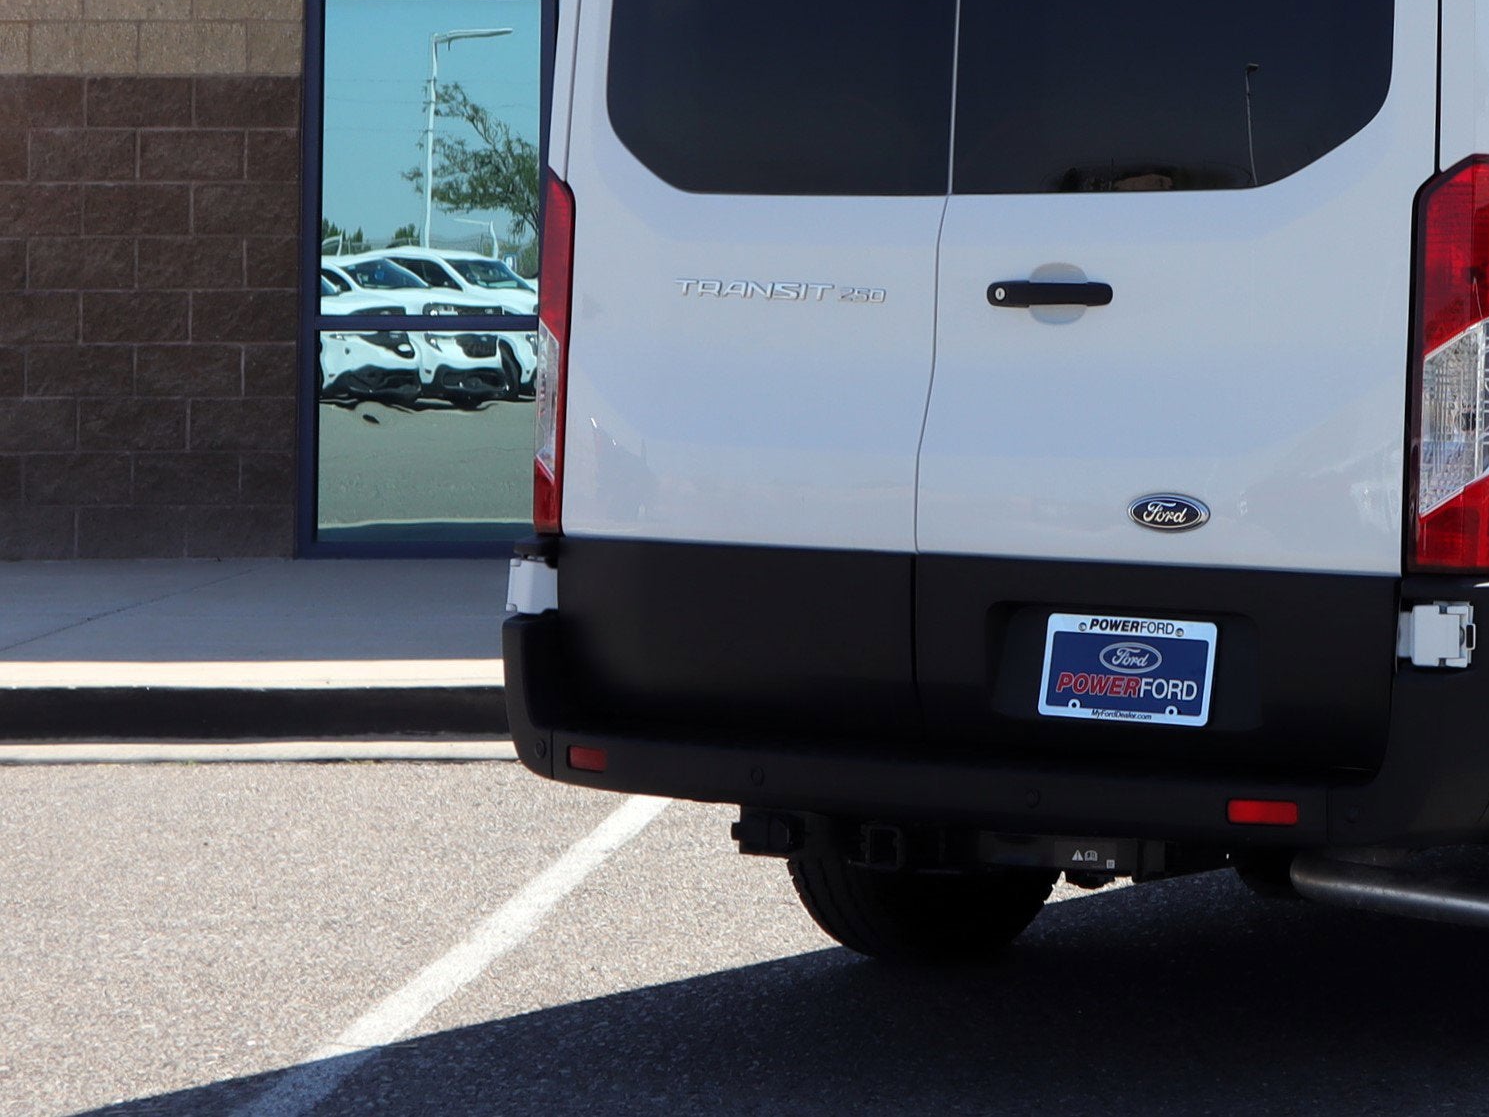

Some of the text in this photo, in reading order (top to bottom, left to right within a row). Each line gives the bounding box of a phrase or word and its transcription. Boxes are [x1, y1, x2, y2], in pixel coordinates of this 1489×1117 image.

[674, 278, 887, 303] TRANSIT 250
[1142, 501, 1188, 523] Ford
[1089, 618, 1175, 636] POWERFORD
[1111, 647, 1149, 667] Ford
[1056, 672, 1198, 701] POWERFORD
[1091, 709, 1152, 720] MyFordDealer.com
